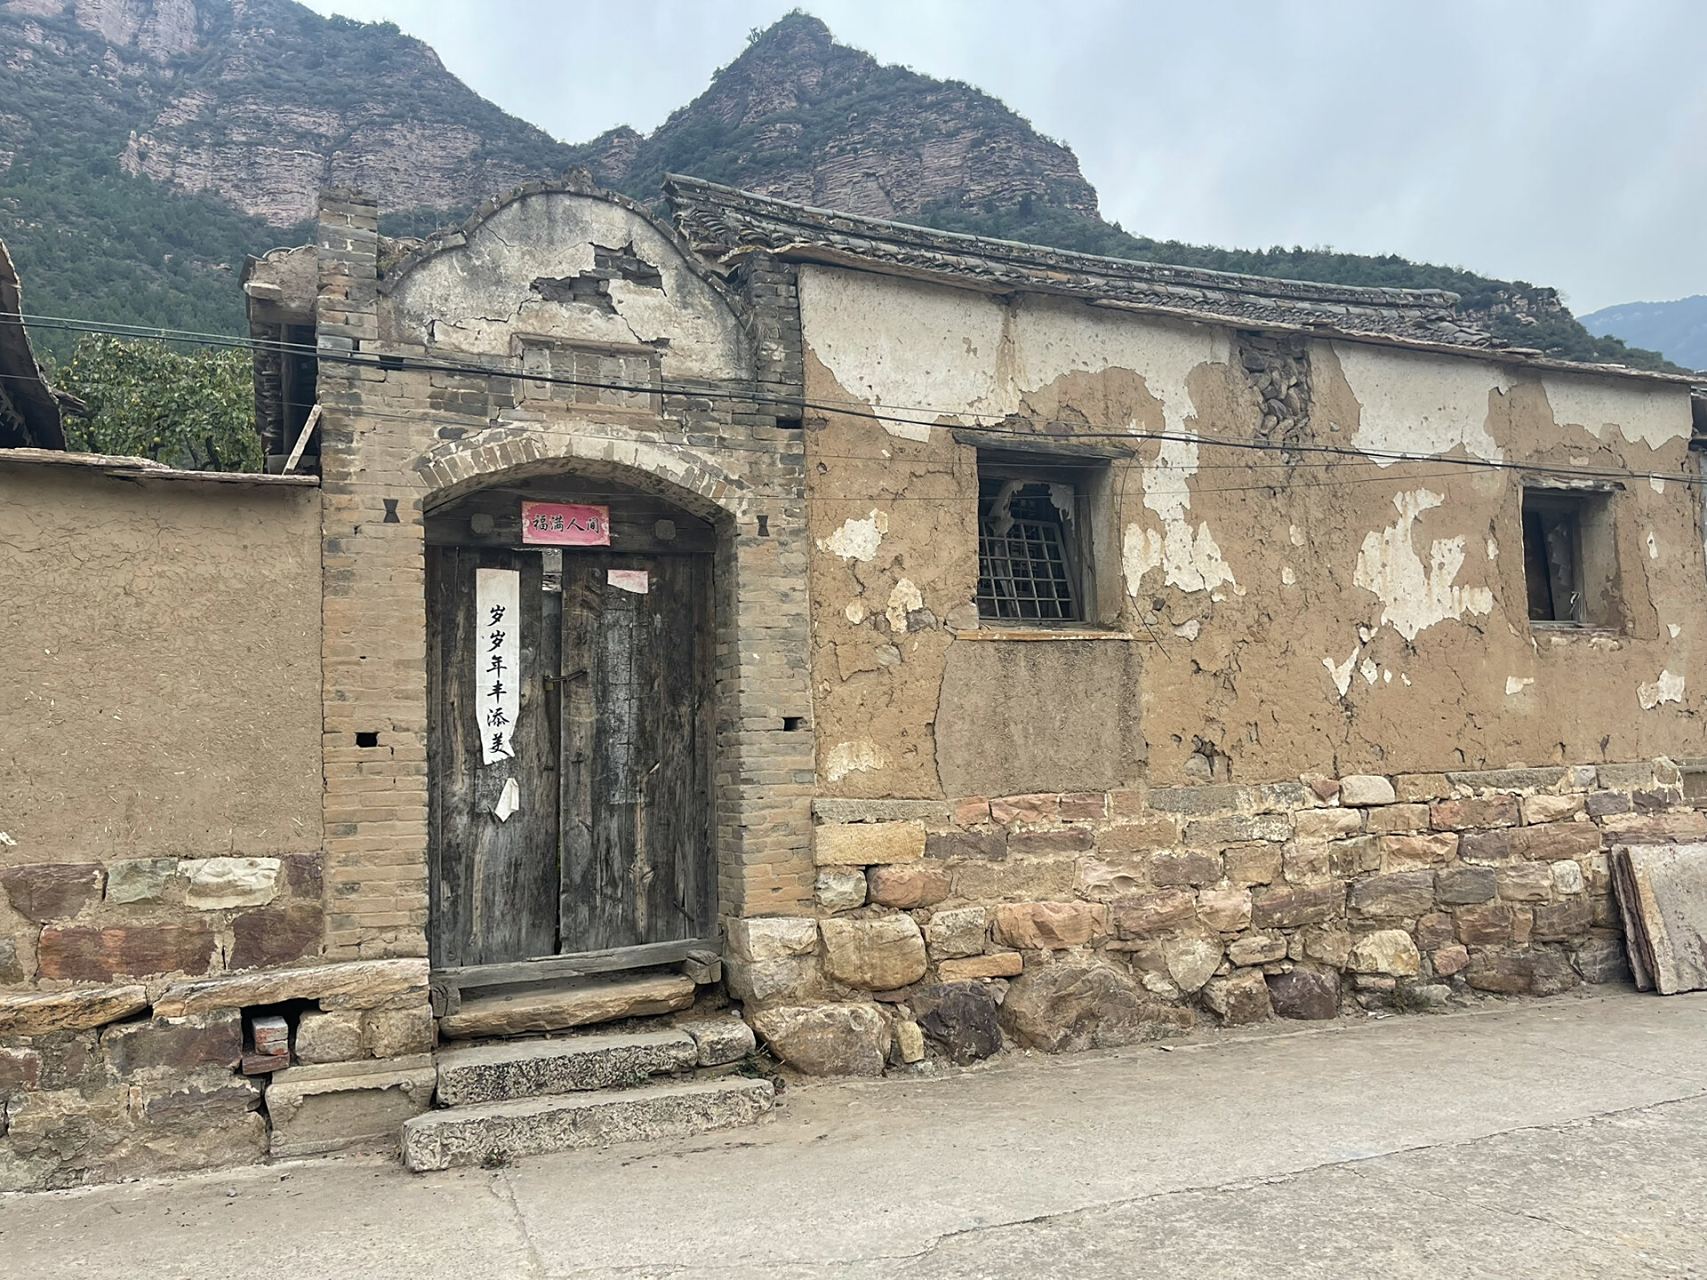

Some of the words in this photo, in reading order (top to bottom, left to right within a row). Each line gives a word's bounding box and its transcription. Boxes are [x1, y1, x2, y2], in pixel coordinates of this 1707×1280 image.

[533, 514, 600, 534] 福满人间
[487, 604, 511, 757] 岁岁年丰添美
